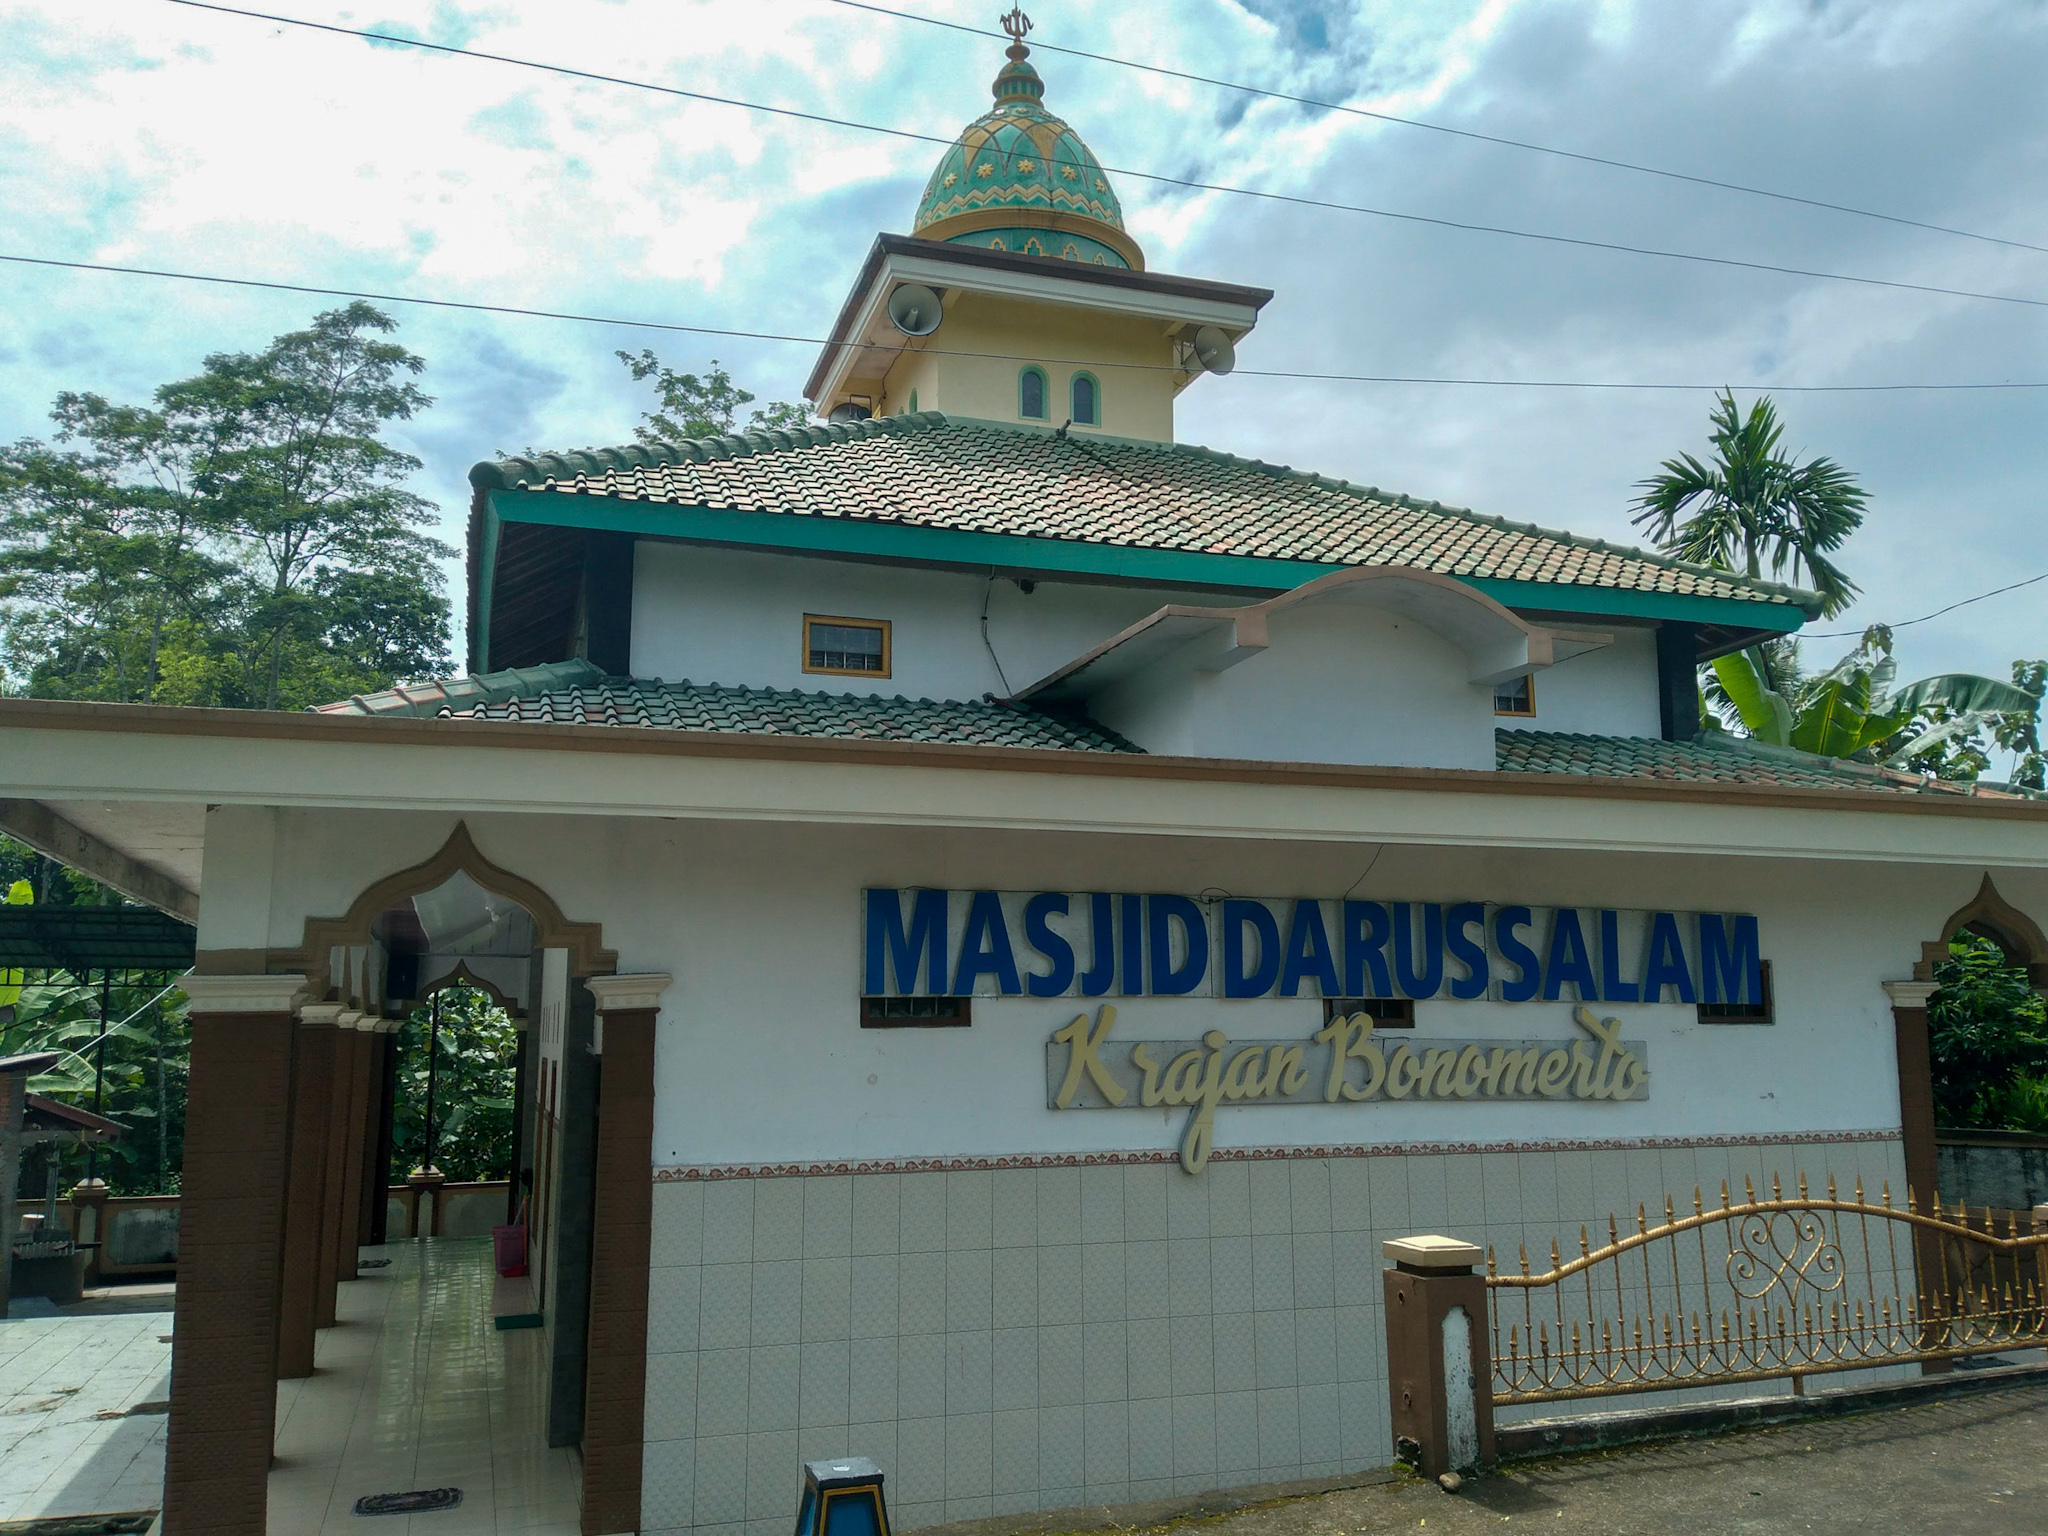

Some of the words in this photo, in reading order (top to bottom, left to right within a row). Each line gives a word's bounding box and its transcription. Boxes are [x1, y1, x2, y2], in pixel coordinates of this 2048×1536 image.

[864, 888, 1209, 997] MASJID
[1223, 899, 1762, 1005] DARUSSALAM
[1053, 1004, 1309, 1174] Krajan
[1315, 1006, 1652, 1102] Bonomerto
